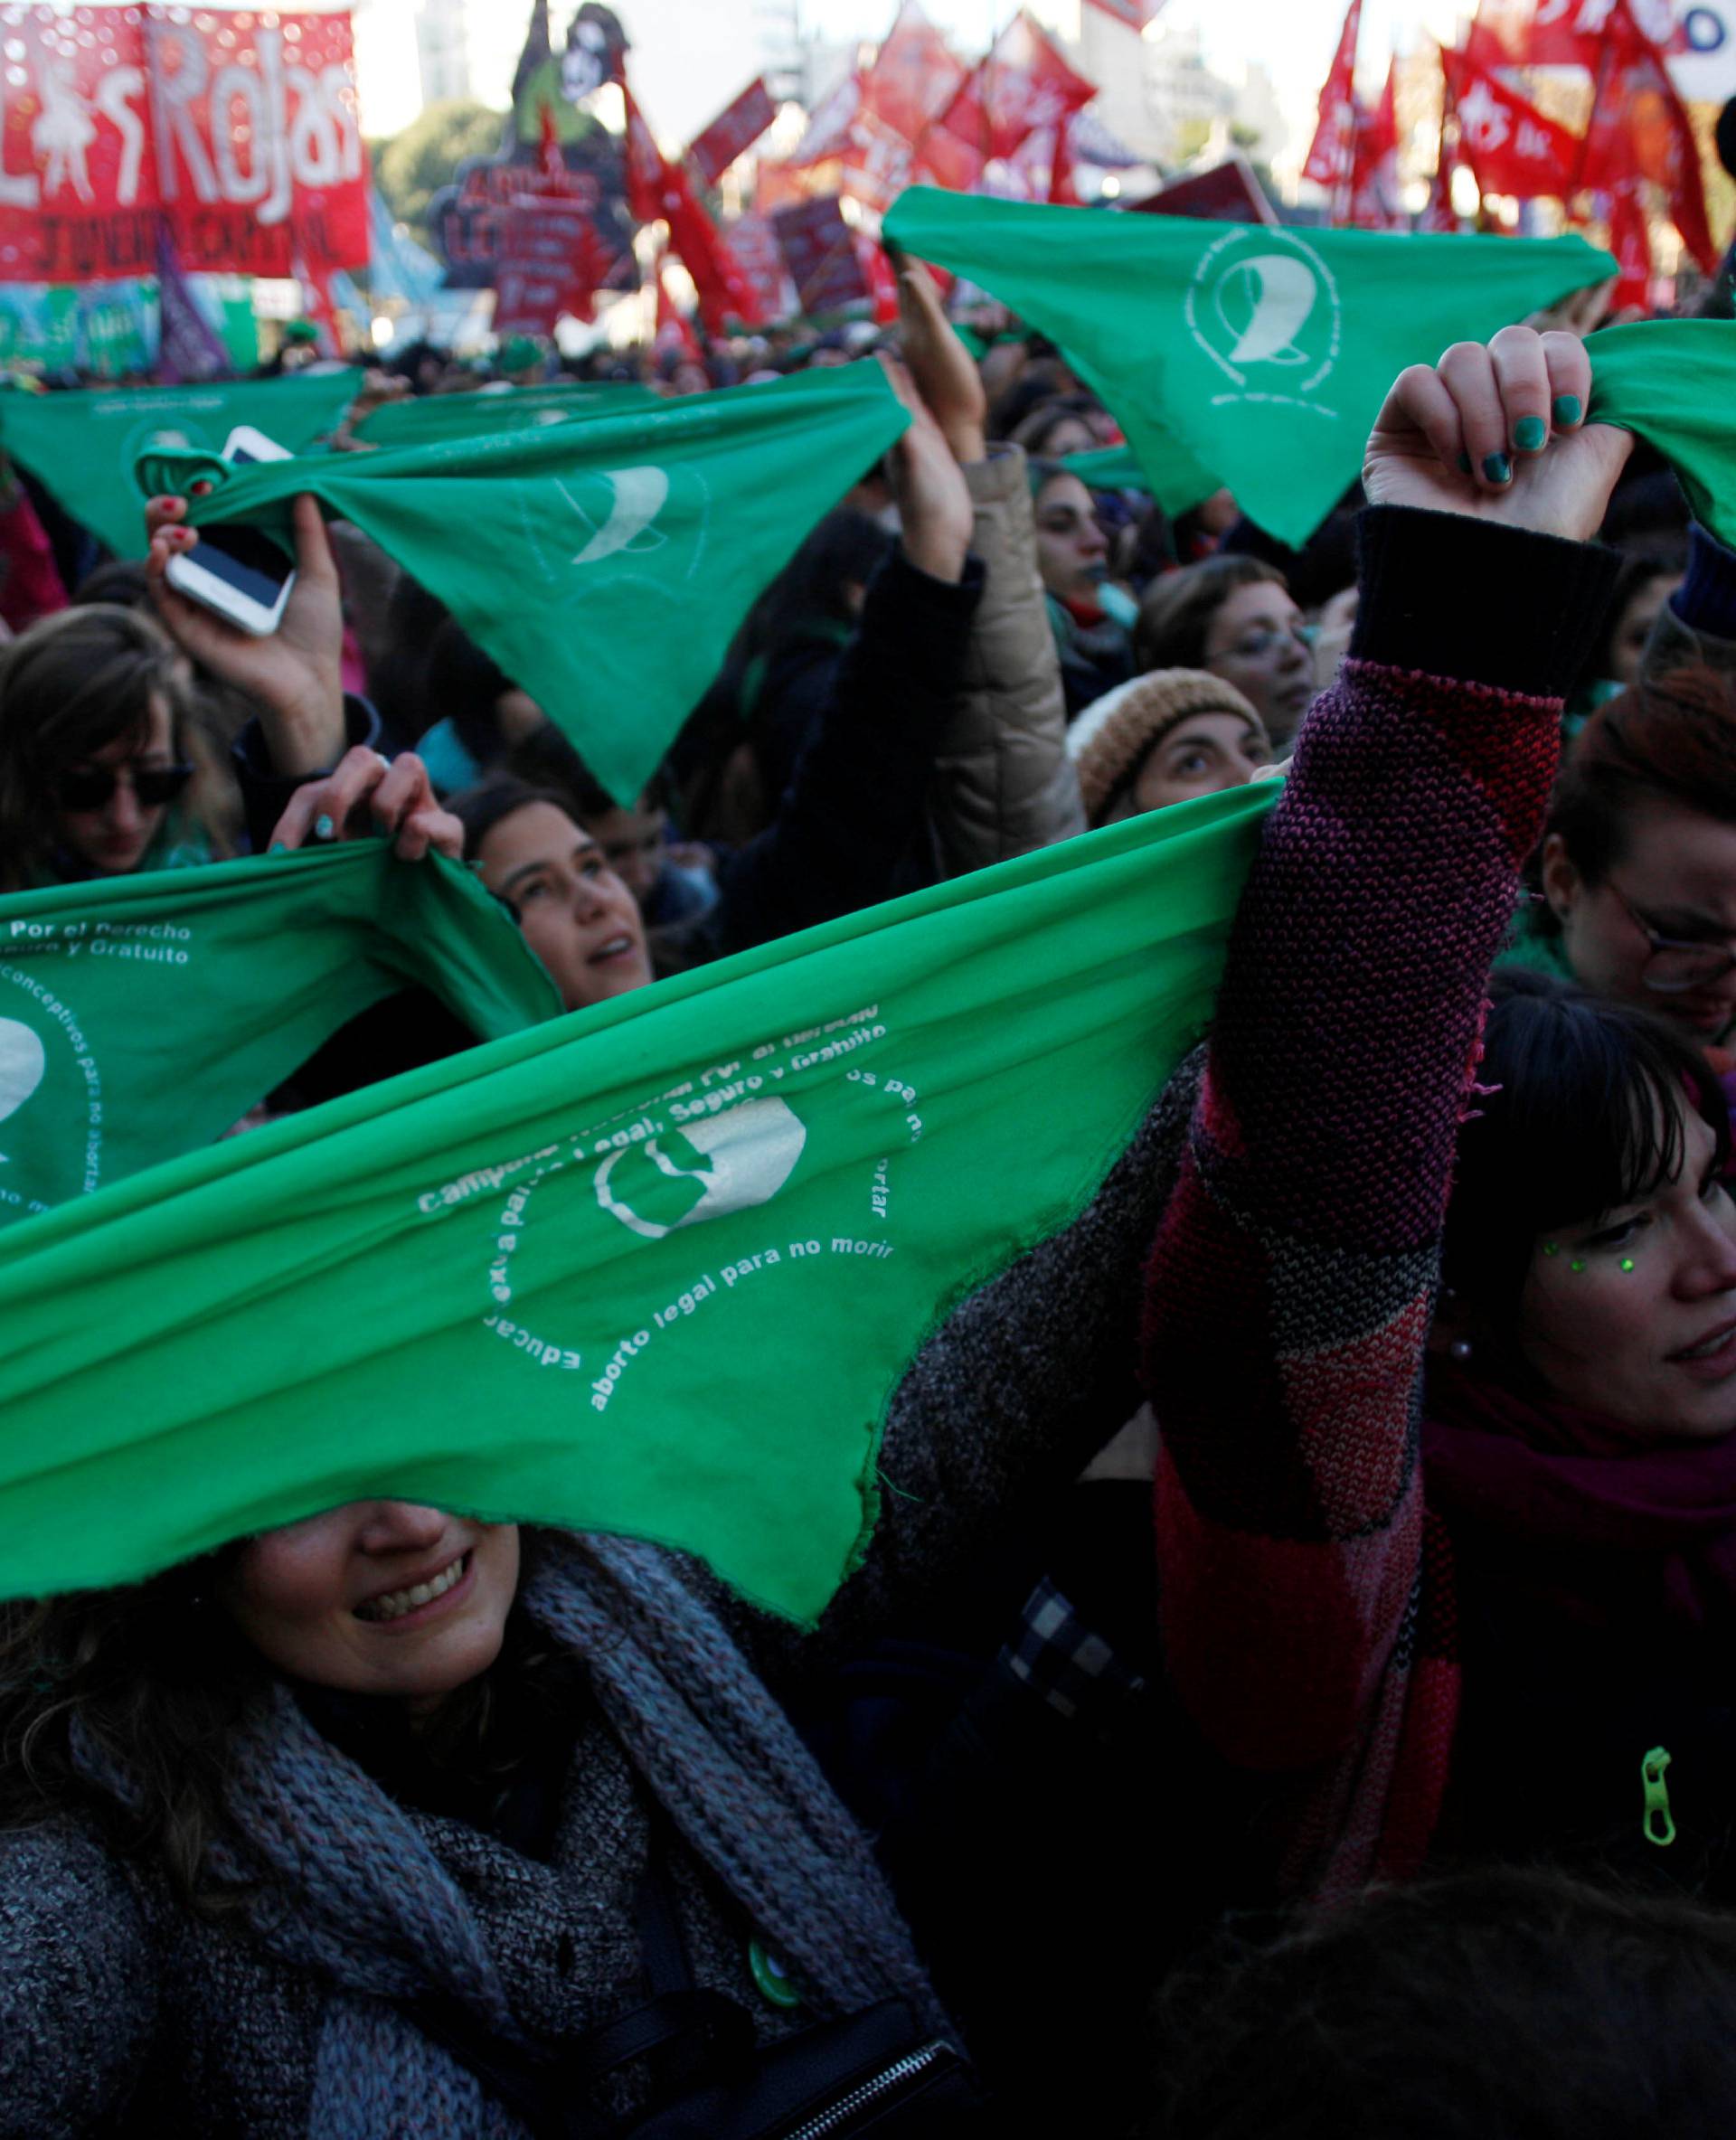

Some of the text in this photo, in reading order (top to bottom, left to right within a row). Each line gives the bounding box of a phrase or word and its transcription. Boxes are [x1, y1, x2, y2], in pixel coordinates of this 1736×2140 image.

[10, 919, 55, 938] Por
[90, 938, 189, 965] Gratuito
[668, 1074, 764, 1121] Seguro
[789, 1023, 887, 1070] Gratuito
[591, 1236, 894, 1411] aborto legal para no morir
